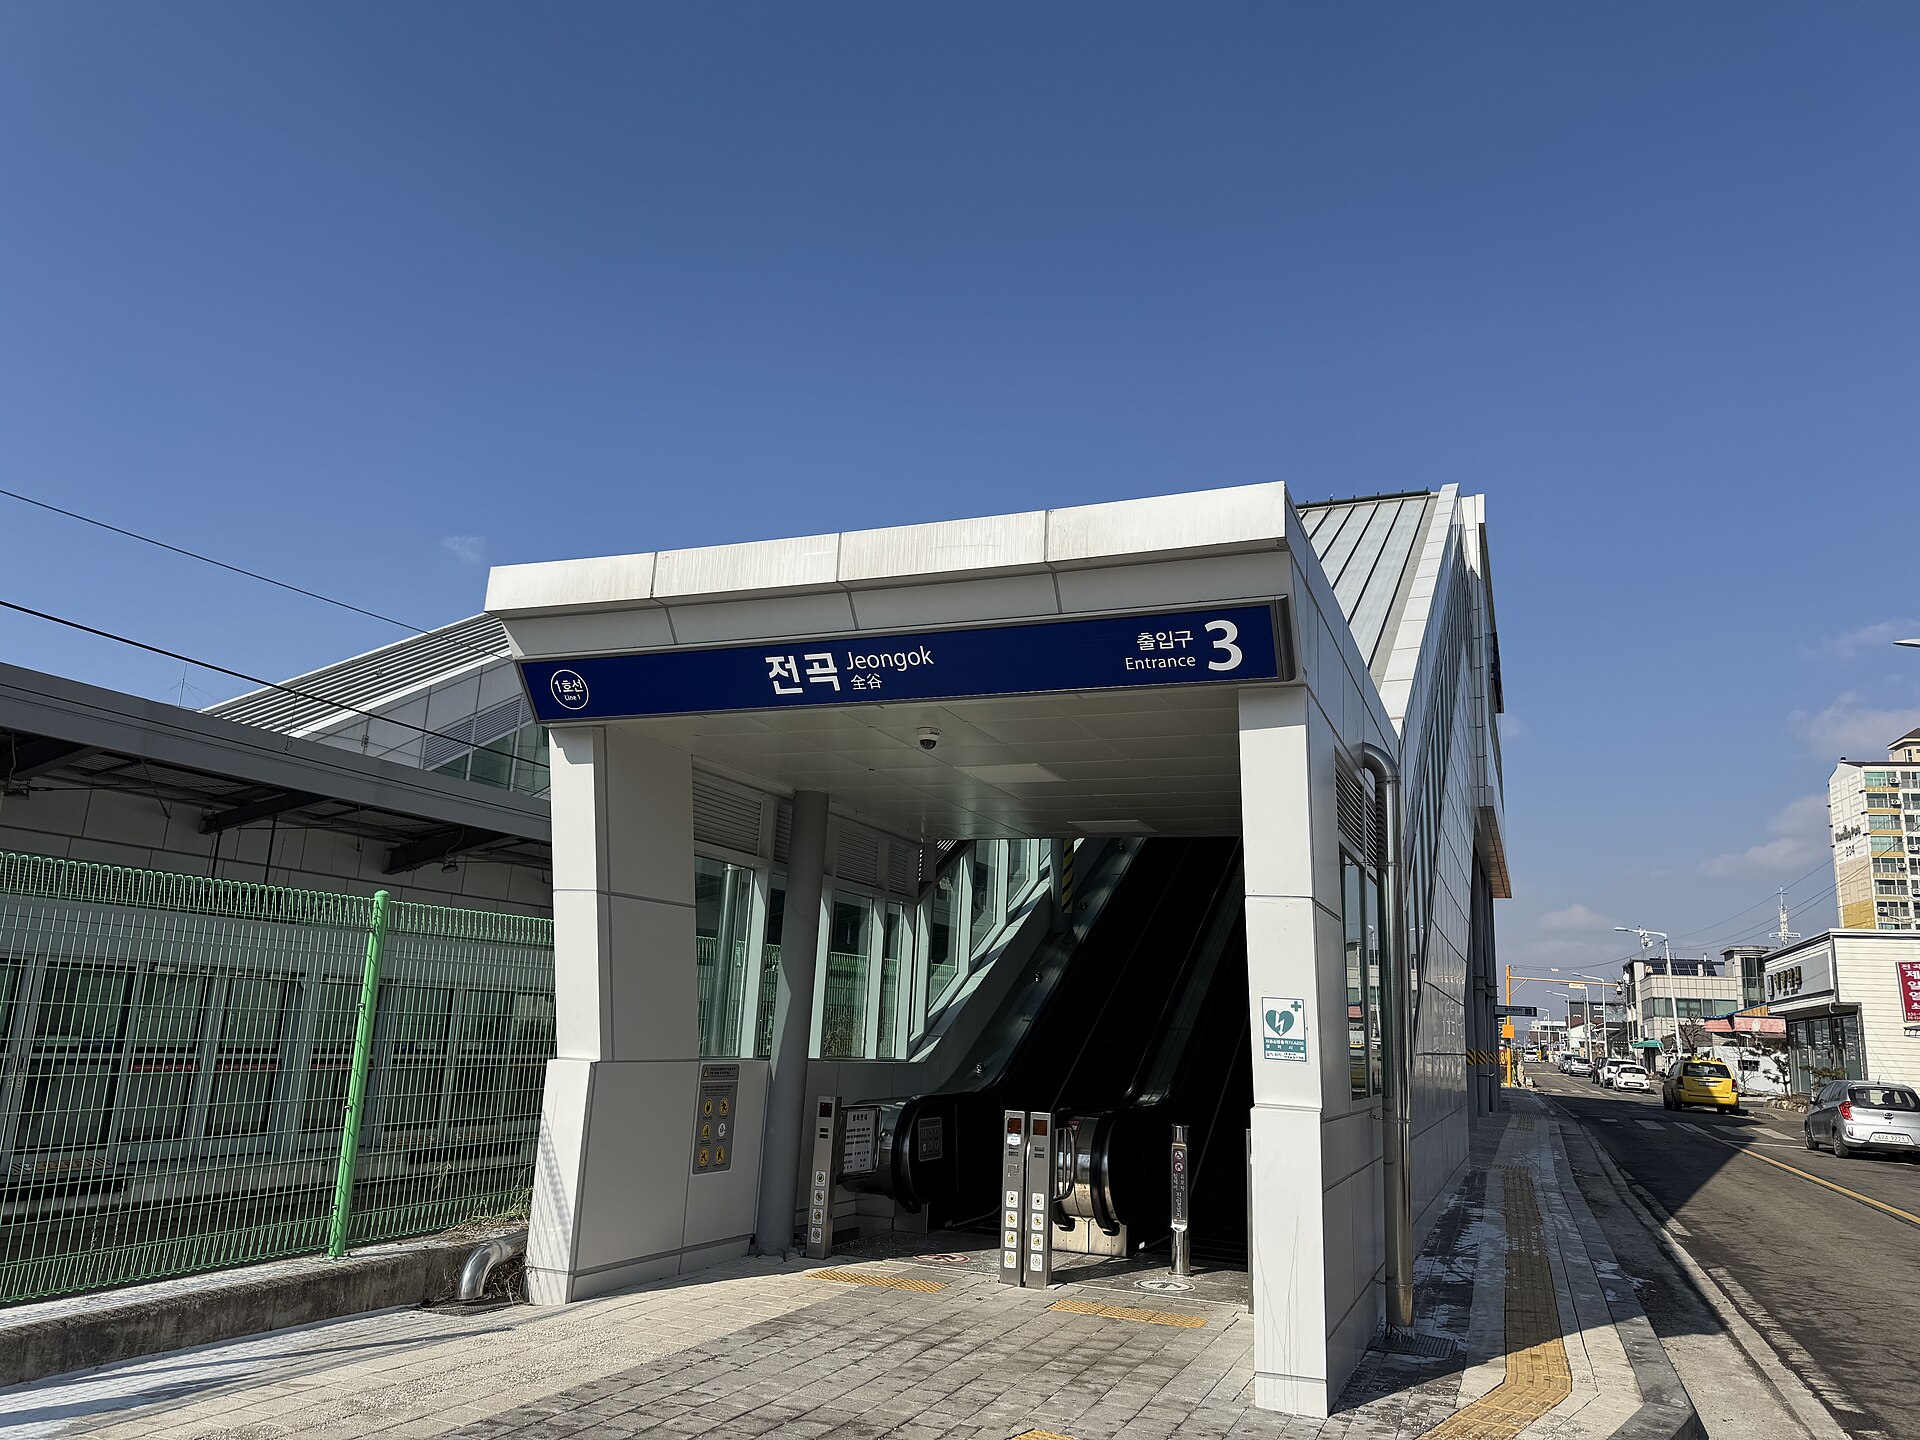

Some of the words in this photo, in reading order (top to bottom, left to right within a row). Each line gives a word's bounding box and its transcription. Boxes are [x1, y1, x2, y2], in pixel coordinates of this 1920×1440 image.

[1136, 630, 1194, 651] 출입구
[1204, 619, 1243, 671] 3
[846, 645, 935, 672] Jeongok
[1125, 655, 1196, 671] Entrance
[765, 652, 841, 695] 전곡
[850, 673, 883, 690] 全谷
[554, 678, 584, 693] 1호선
